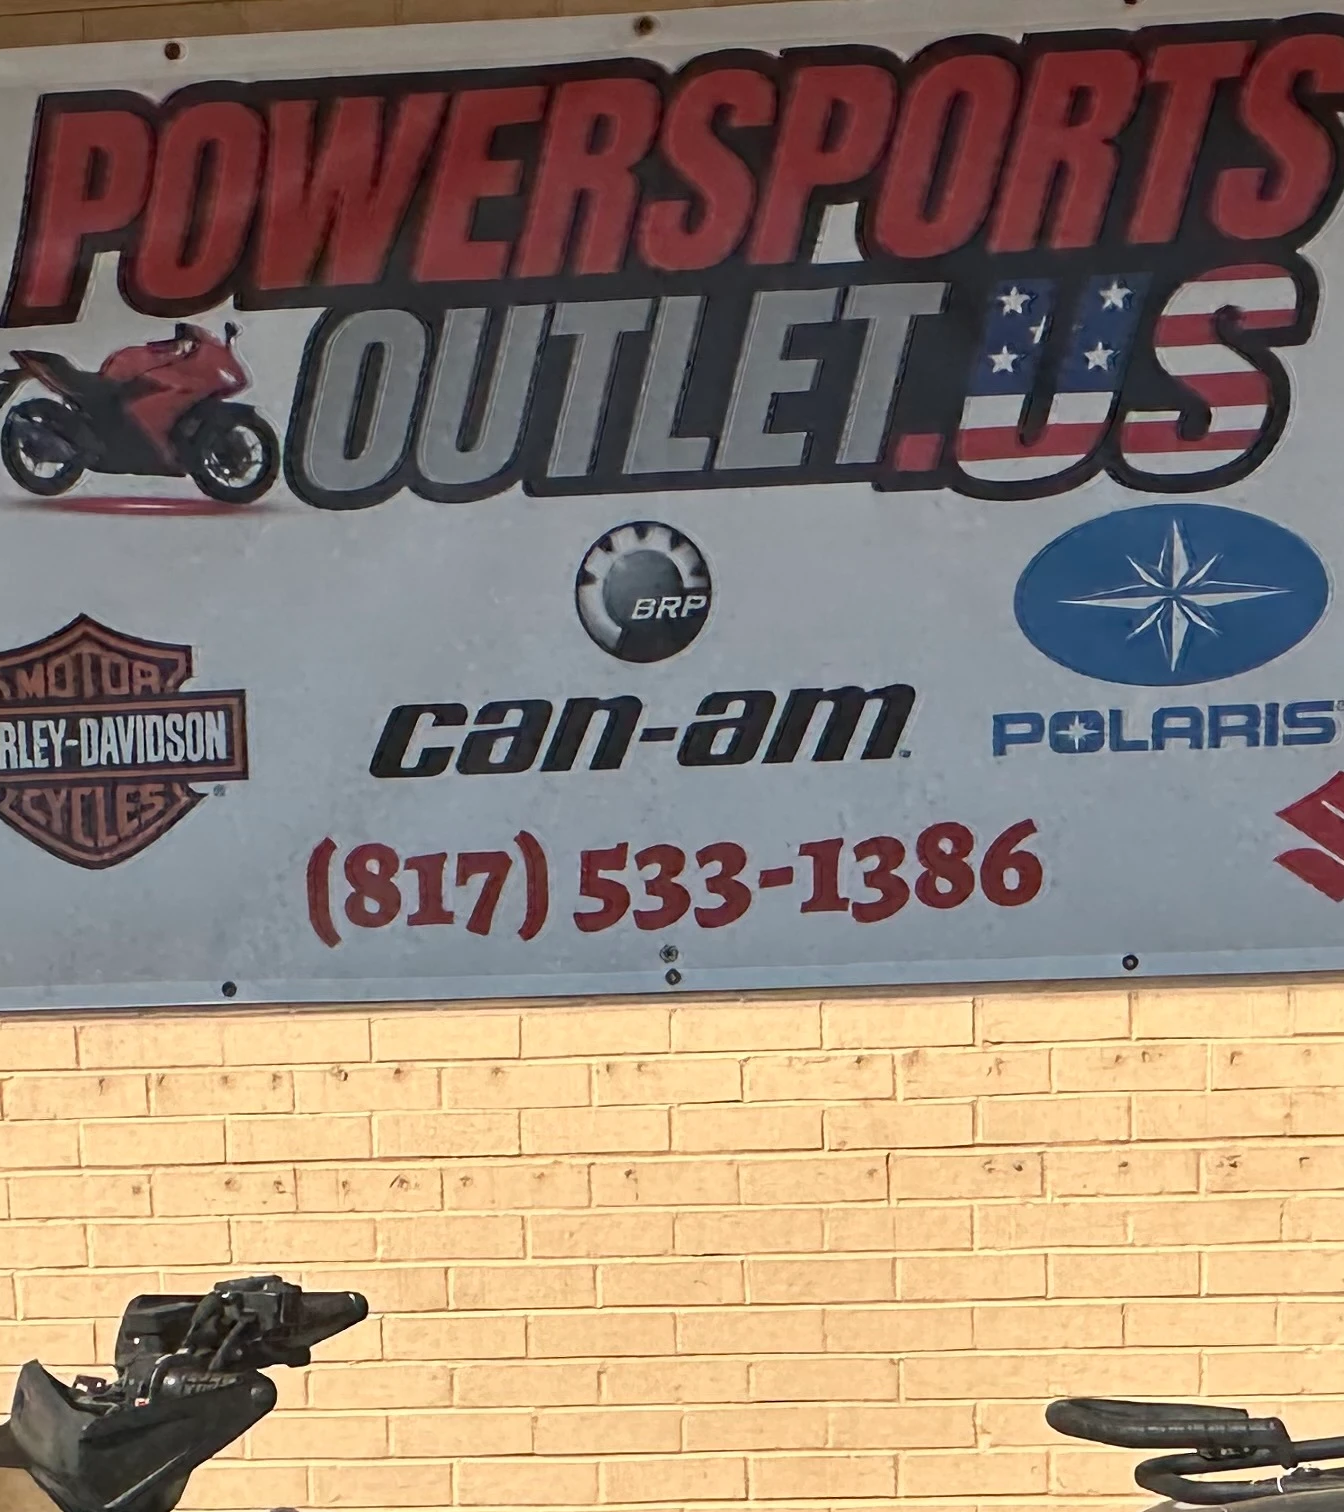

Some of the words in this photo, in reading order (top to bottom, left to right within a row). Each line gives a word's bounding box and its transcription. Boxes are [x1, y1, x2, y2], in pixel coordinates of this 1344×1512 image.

[303, 264, 1296, 493] OUTLET.US
[631, 593, 708, 620] BRP
[16, 659, 162, 701] MOTOR
[368, 683, 917, 779] can-am
[992, 701, 1338, 756] POLARIS
[18, 786, 166, 846] CYCLES
[306, 829, 549, 948] (817)
[573, 817, 1043, 930] 533-1386
